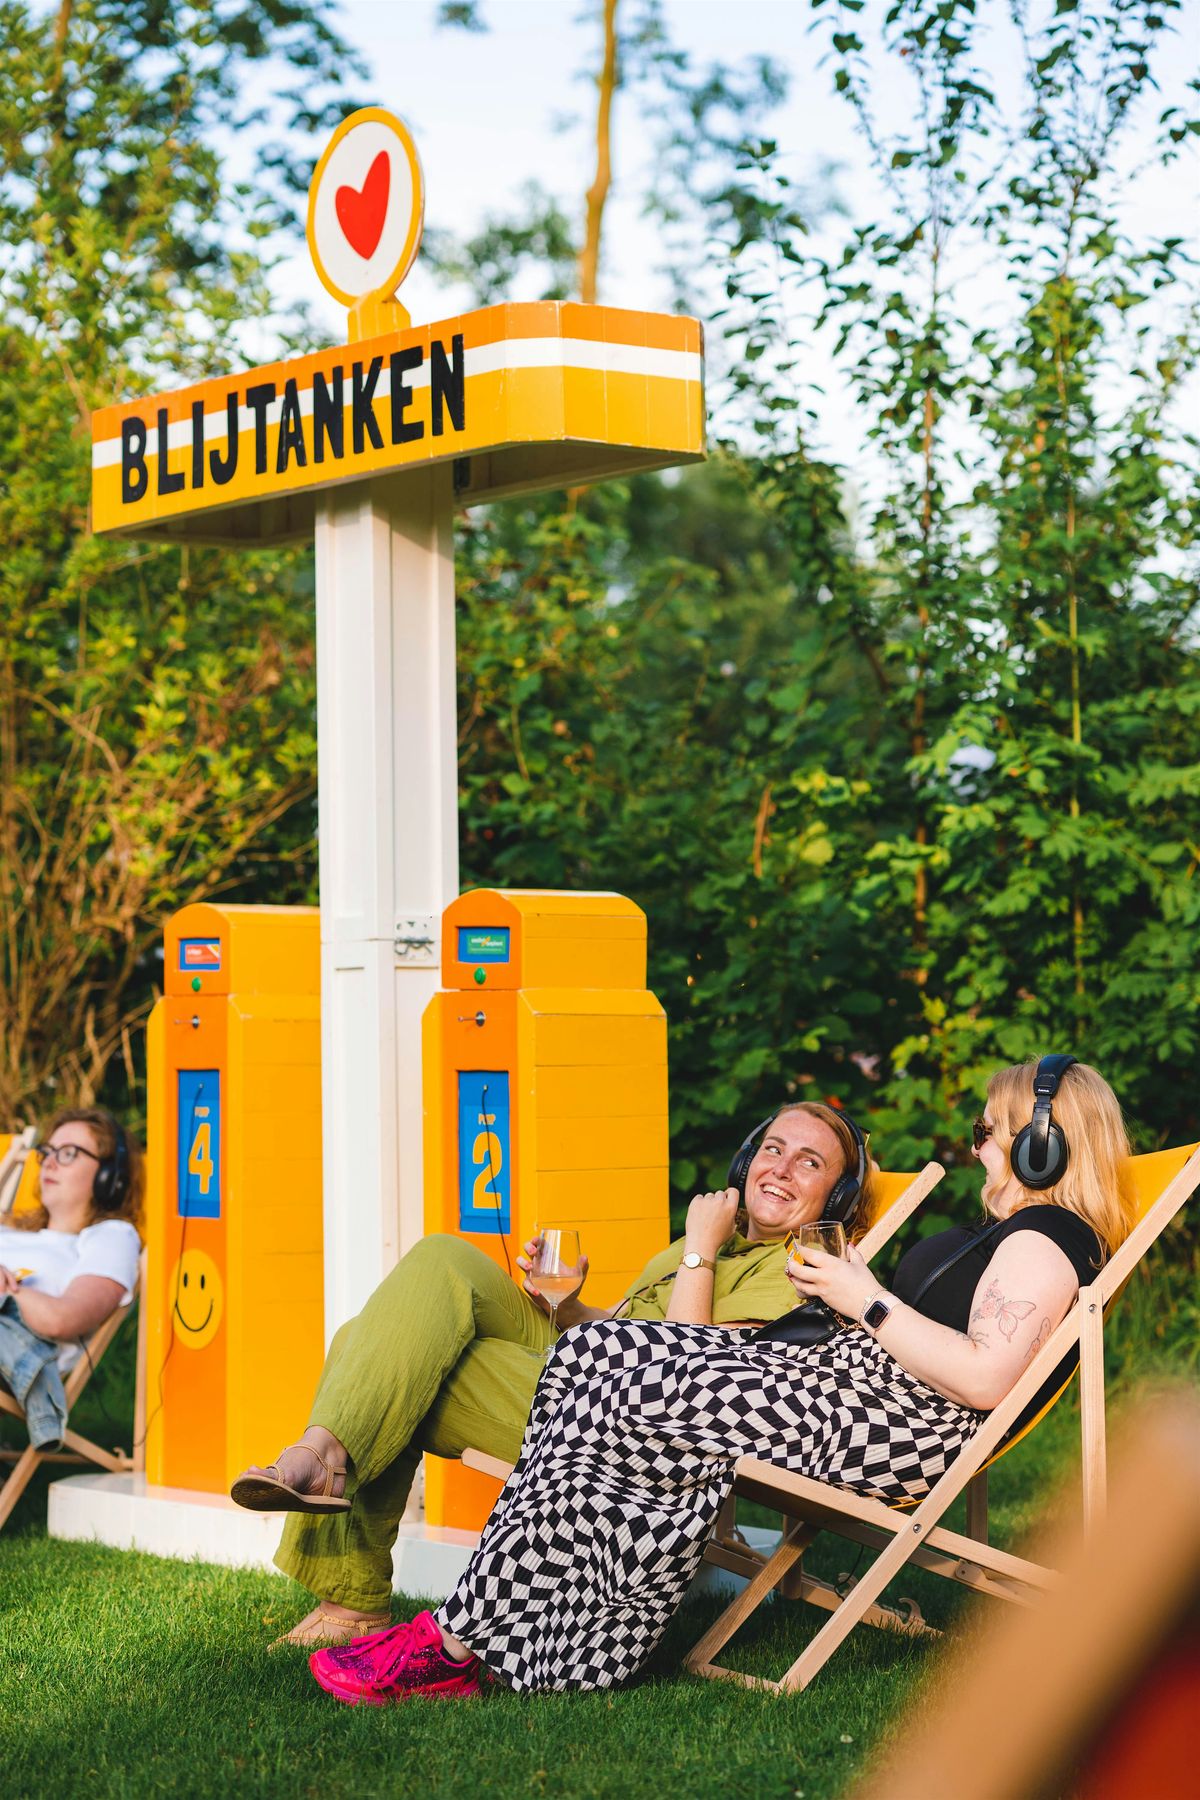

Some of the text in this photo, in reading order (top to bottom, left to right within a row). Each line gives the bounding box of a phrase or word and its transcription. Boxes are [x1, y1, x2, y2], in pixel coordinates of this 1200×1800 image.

[121, 333, 466, 504] BLIJTANKEN
[188, 1122, 213, 1194] 4
[472, 1131, 502, 1209] 2
